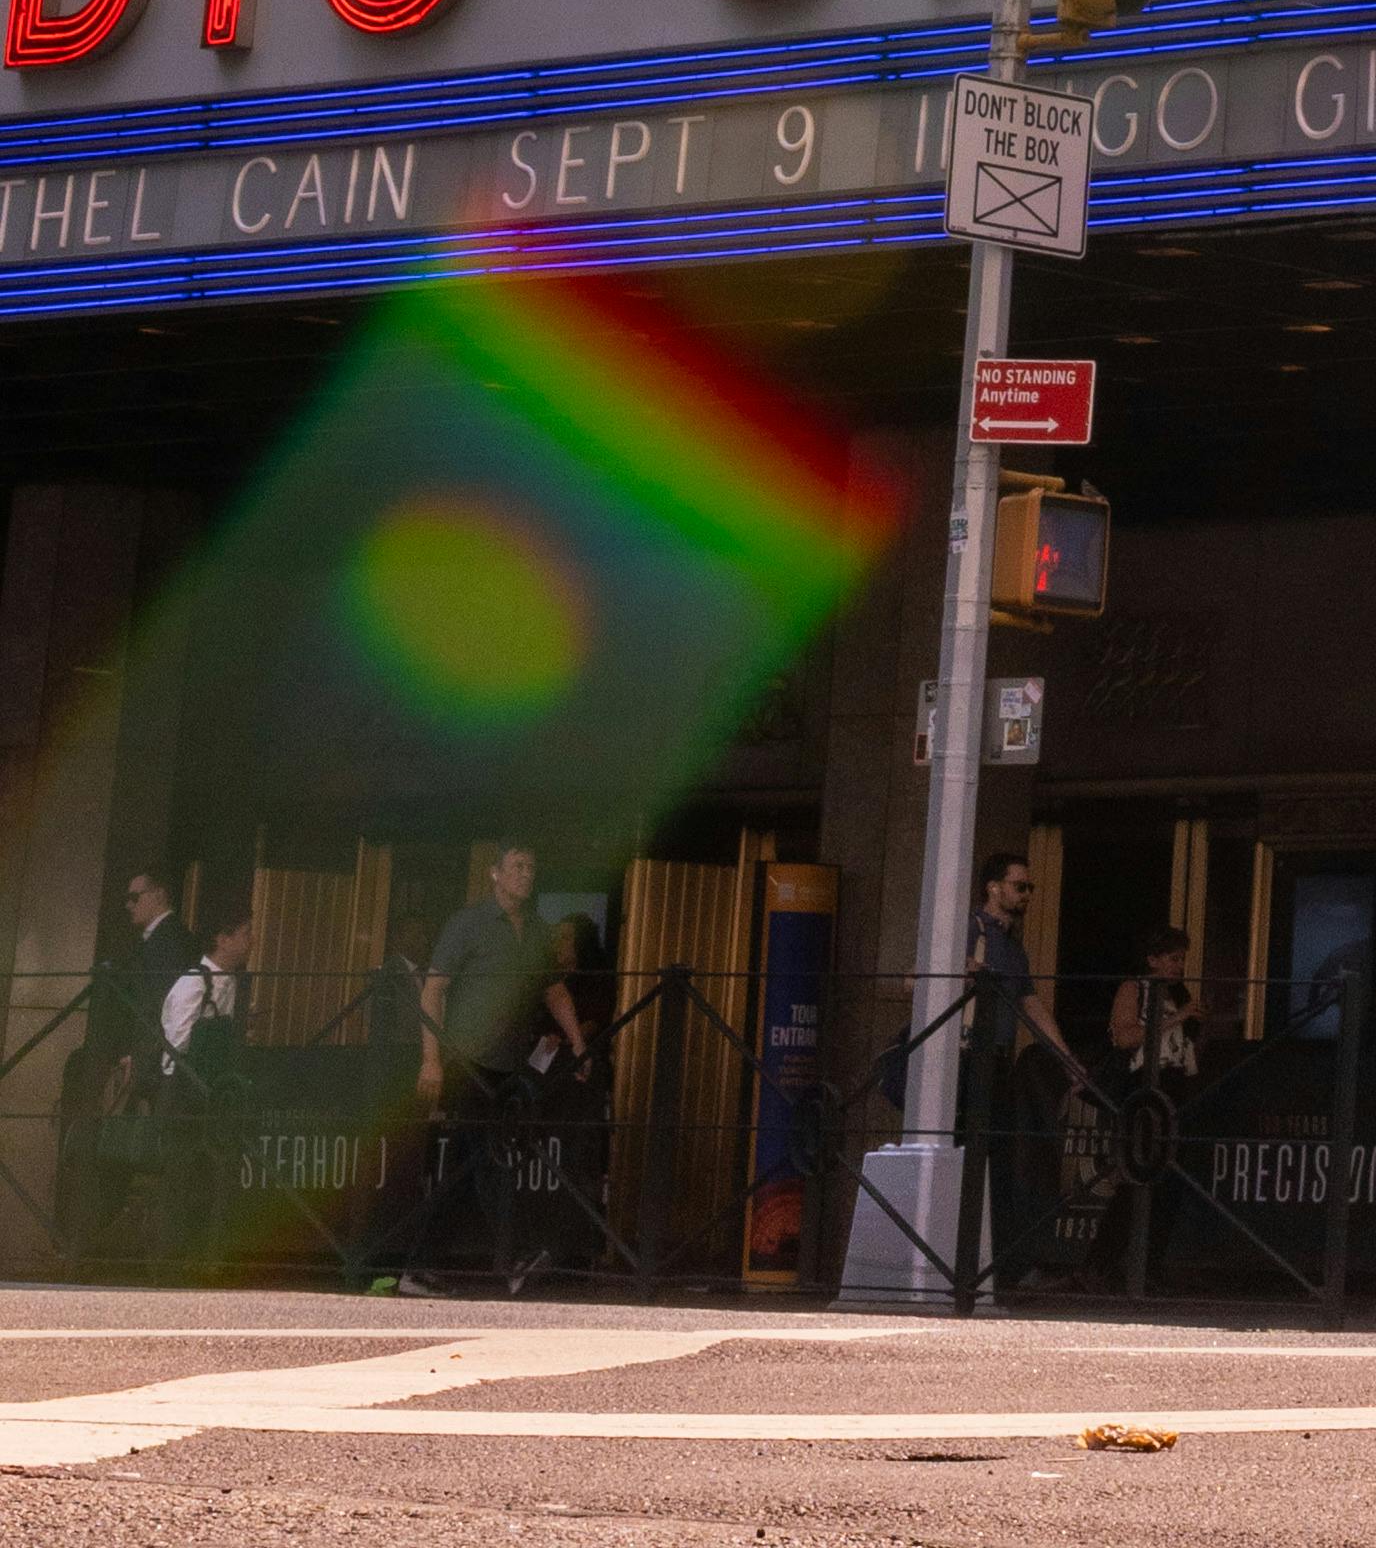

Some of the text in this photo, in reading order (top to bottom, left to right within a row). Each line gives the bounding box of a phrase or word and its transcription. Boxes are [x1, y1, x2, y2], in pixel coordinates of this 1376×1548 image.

[964, 88, 1083, 137] DON'T BLOCK
[984, 126, 1061, 168] THE BOX
[230, 144, 416, 235] CAIN
[501, 114, 707, 211] SEPT
[772, 104, 815, 185] 9
[980, 388, 1040, 406] Anytime
[981, 368, 1077, 386] NO STANDING
